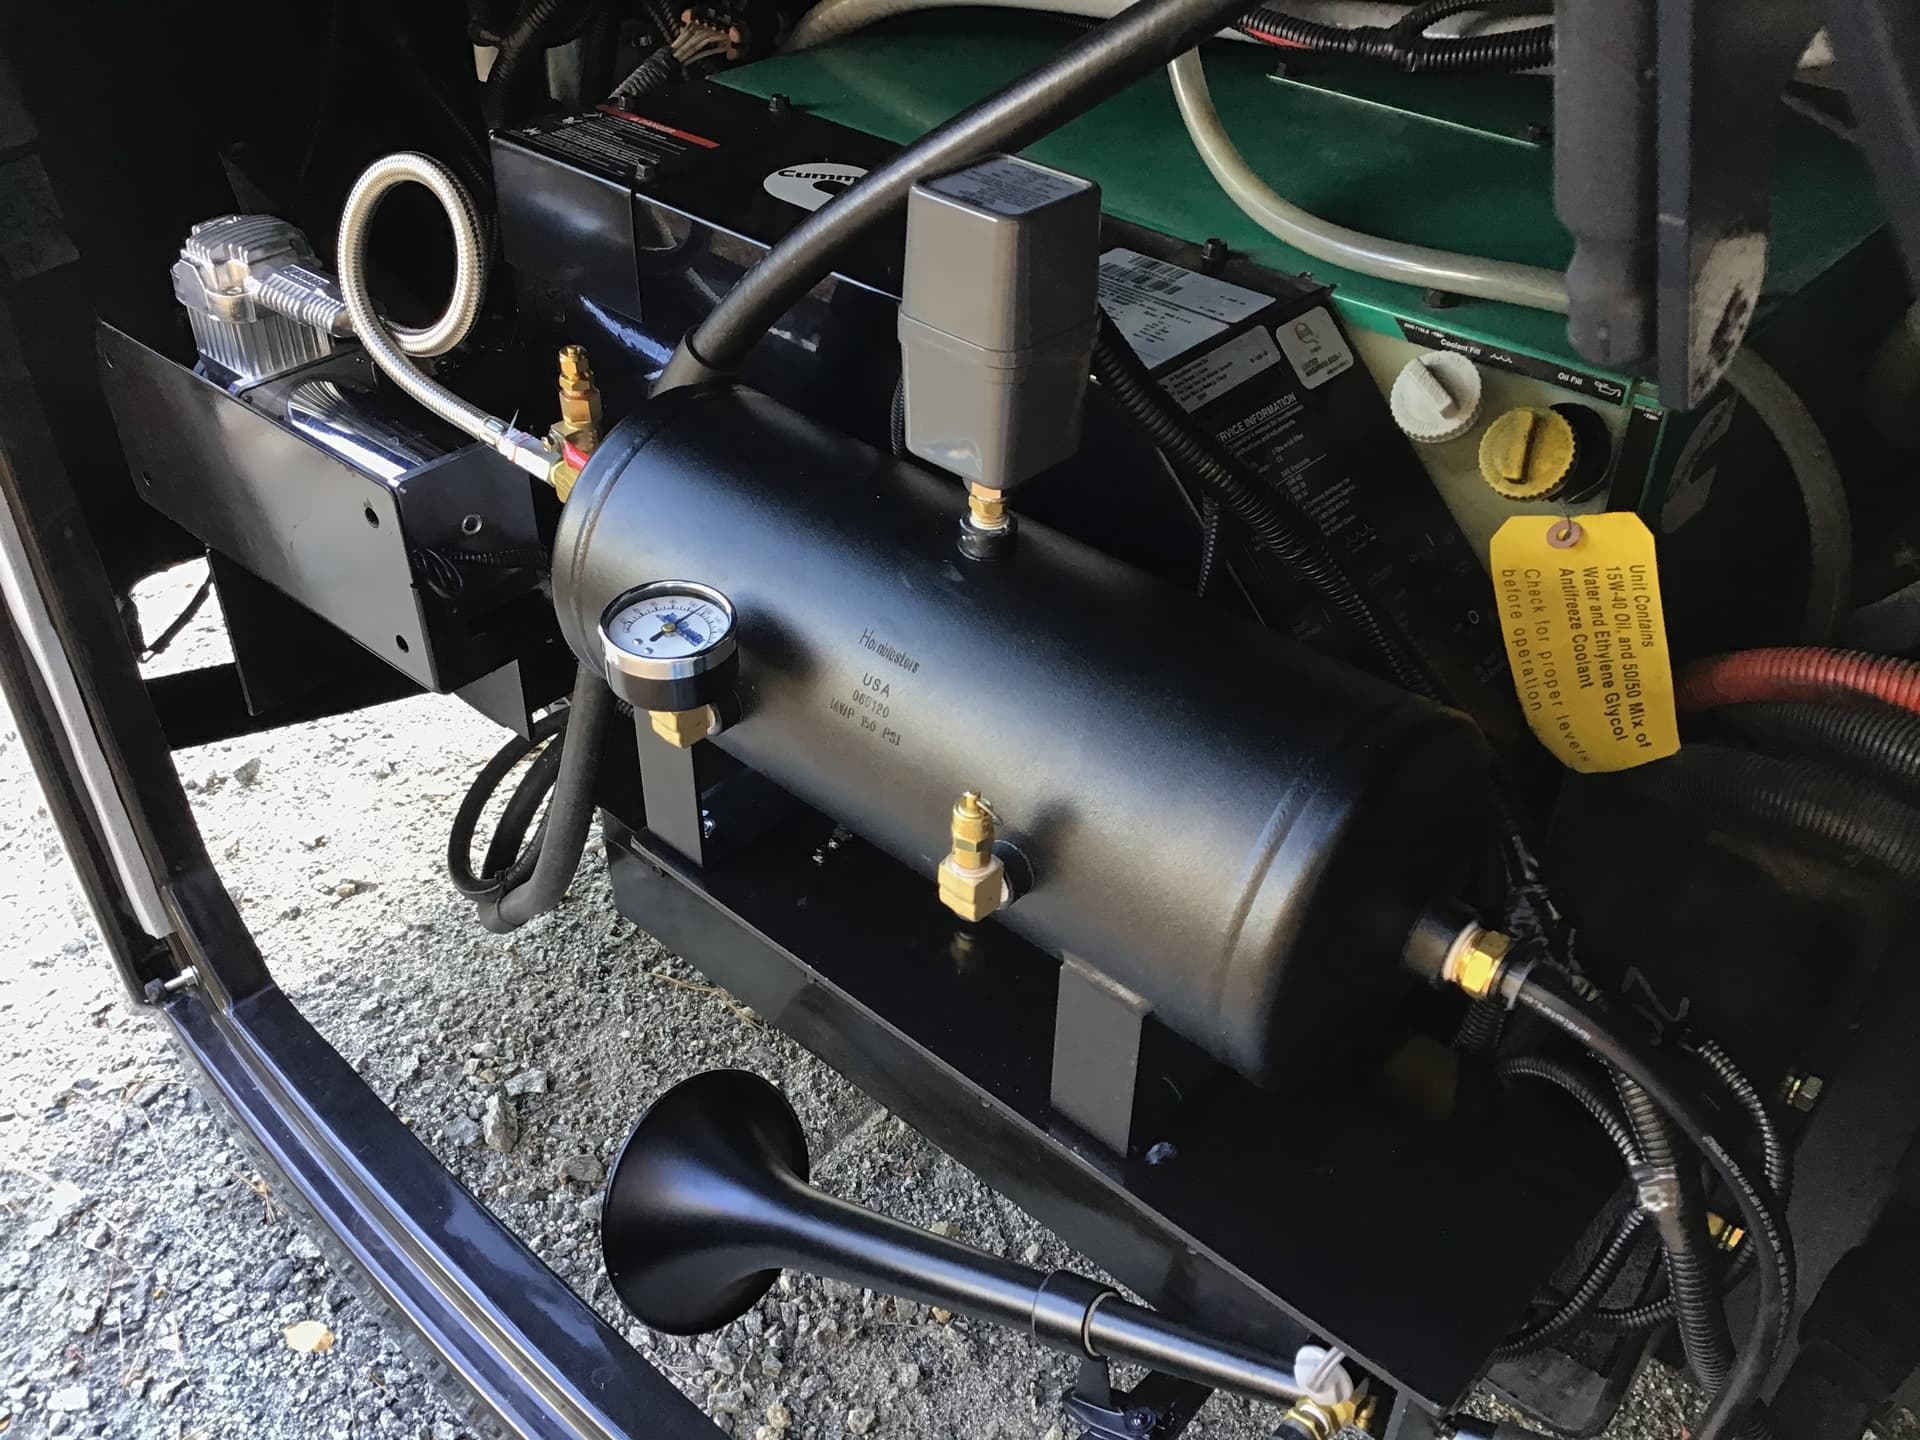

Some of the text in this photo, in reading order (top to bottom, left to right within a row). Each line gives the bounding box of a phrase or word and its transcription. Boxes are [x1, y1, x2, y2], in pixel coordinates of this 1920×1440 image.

[777, 169, 859, 182] Cumm
[1440, 338, 1481, 356] Coolant Fill
[1558, 372, 1583, 386] Oil Fill
[1244, 391, 1297, 428] INFORMATION
[1502, 569, 1522, 619] before
[1524, 568, 1547, 613] Check
[1629, 564, 1656, 647] Unit Contains
[1535, 620, 1551, 641] for
[1558, 568, 1594, 689] Antifreeze Coolant
[1582, 566, 1629, 741] Water and Ethylene Glycol
[1605, 565, 1652, 748] 15W-40 Oil, and 50/50 Mix of
[863, 672, 890, 698] USA
[1537, 651, 1563, 706] proper
[882, 727, 902, 746] PSI
